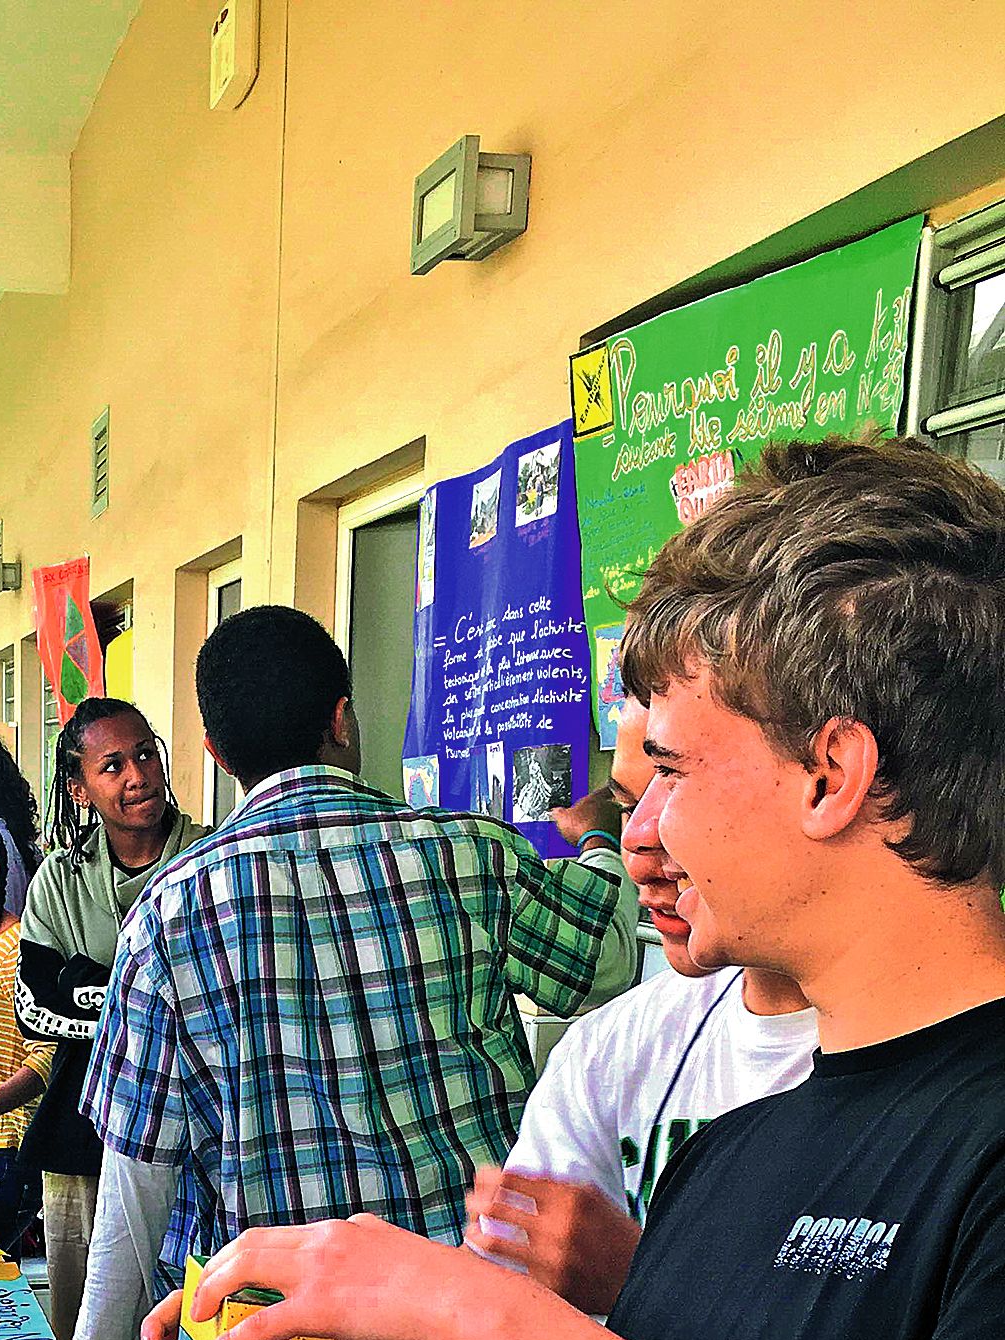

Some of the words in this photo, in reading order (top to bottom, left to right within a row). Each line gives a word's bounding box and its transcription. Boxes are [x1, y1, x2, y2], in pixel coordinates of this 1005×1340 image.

[610, 338, 739, 442] Pourquoi
[750, 329, 783, 399] il
[814, 387, 846, 426] en
[674, 449, 735, 496] EARTH
[529, 596, 551, 614] cette
[508, 629, 526, 658] que
[540, 648, 573, 660] avec
[536, 665, 587, 684] violents,
[536, 717, 554, 730] de
